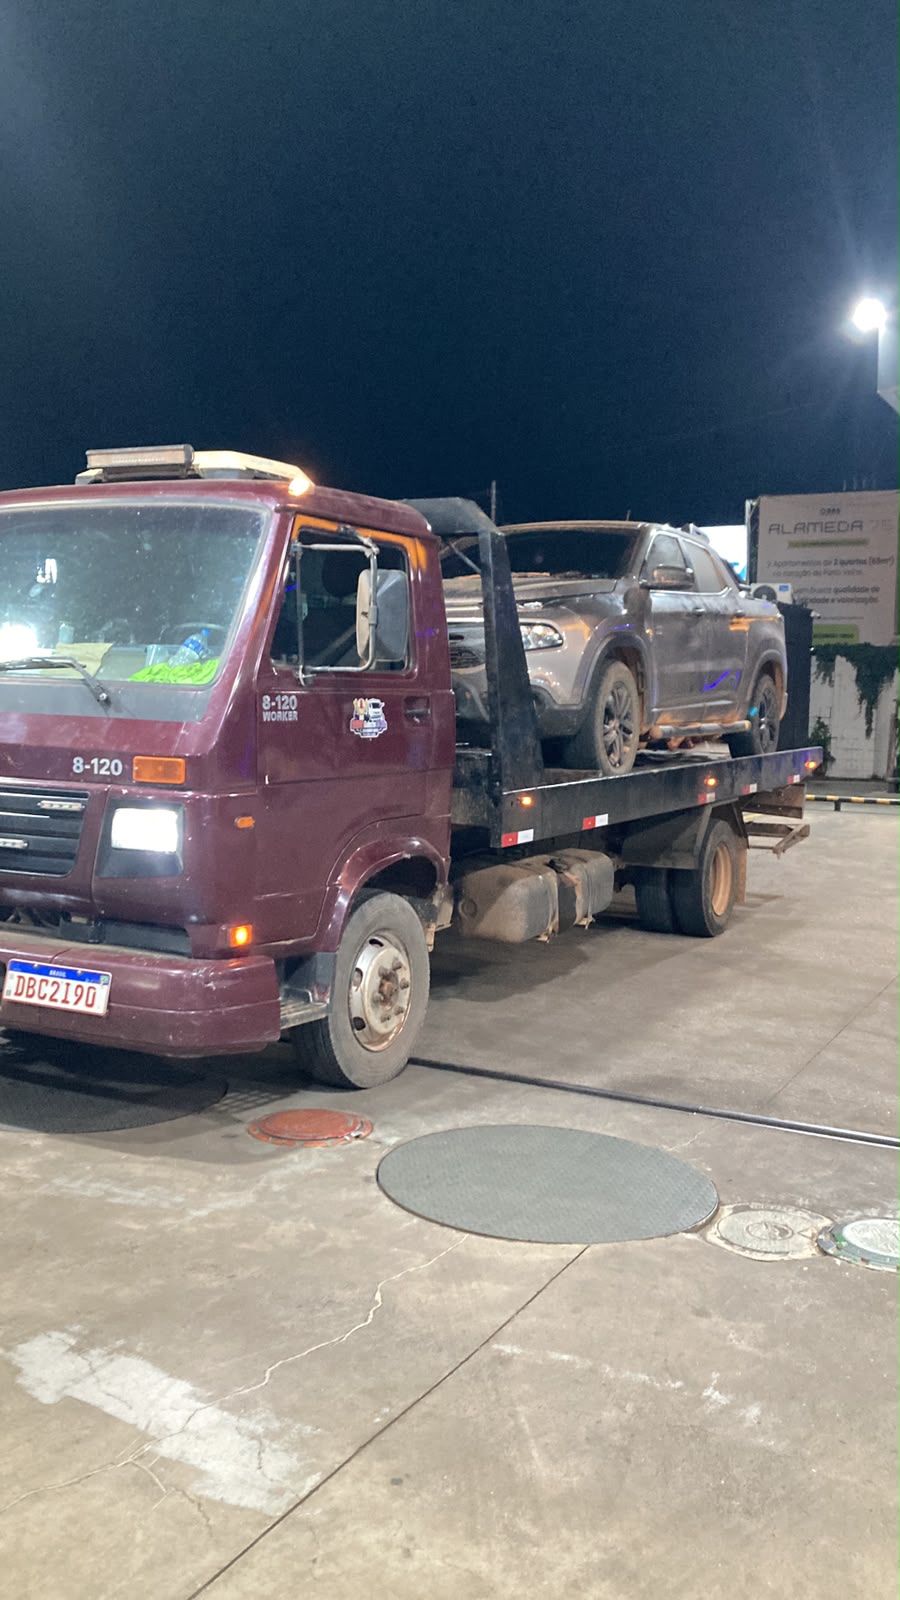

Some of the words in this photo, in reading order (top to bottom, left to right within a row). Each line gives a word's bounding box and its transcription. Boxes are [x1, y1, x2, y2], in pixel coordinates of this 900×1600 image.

[768, 520, 864, 535] ALAMEDA
[262, 695, 298, 710] 8-120
[262, 710, 299, 722] WORKER
[72, 756, 123, 776] 8-120
